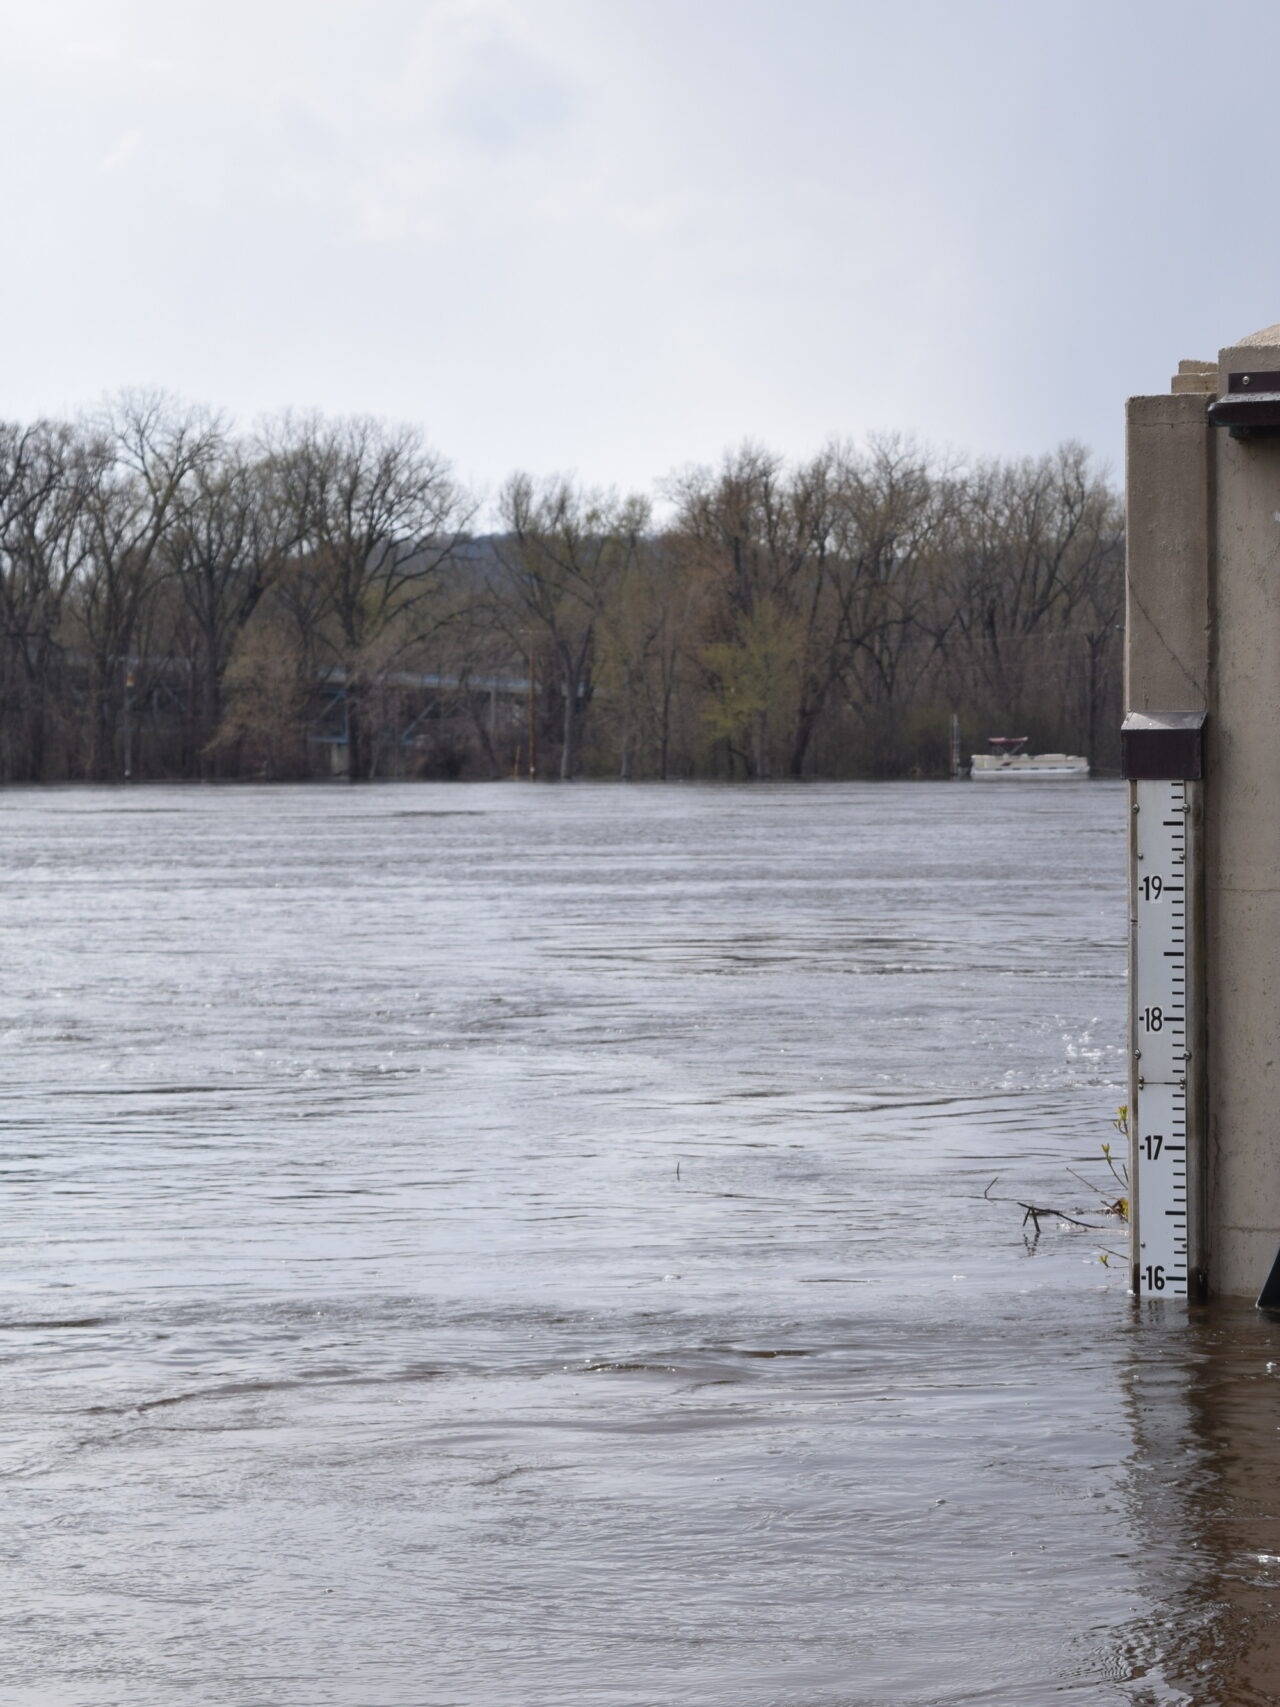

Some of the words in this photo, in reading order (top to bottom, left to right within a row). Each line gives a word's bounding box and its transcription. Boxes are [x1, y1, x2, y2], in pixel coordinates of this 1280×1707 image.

[1143, 875, 1162, 900] 19
[1145, 1007, 1162, 1032] 18
[1145, 1136, 1163, 1160] 17
[1146, 1266, 1165, 1290] 16
